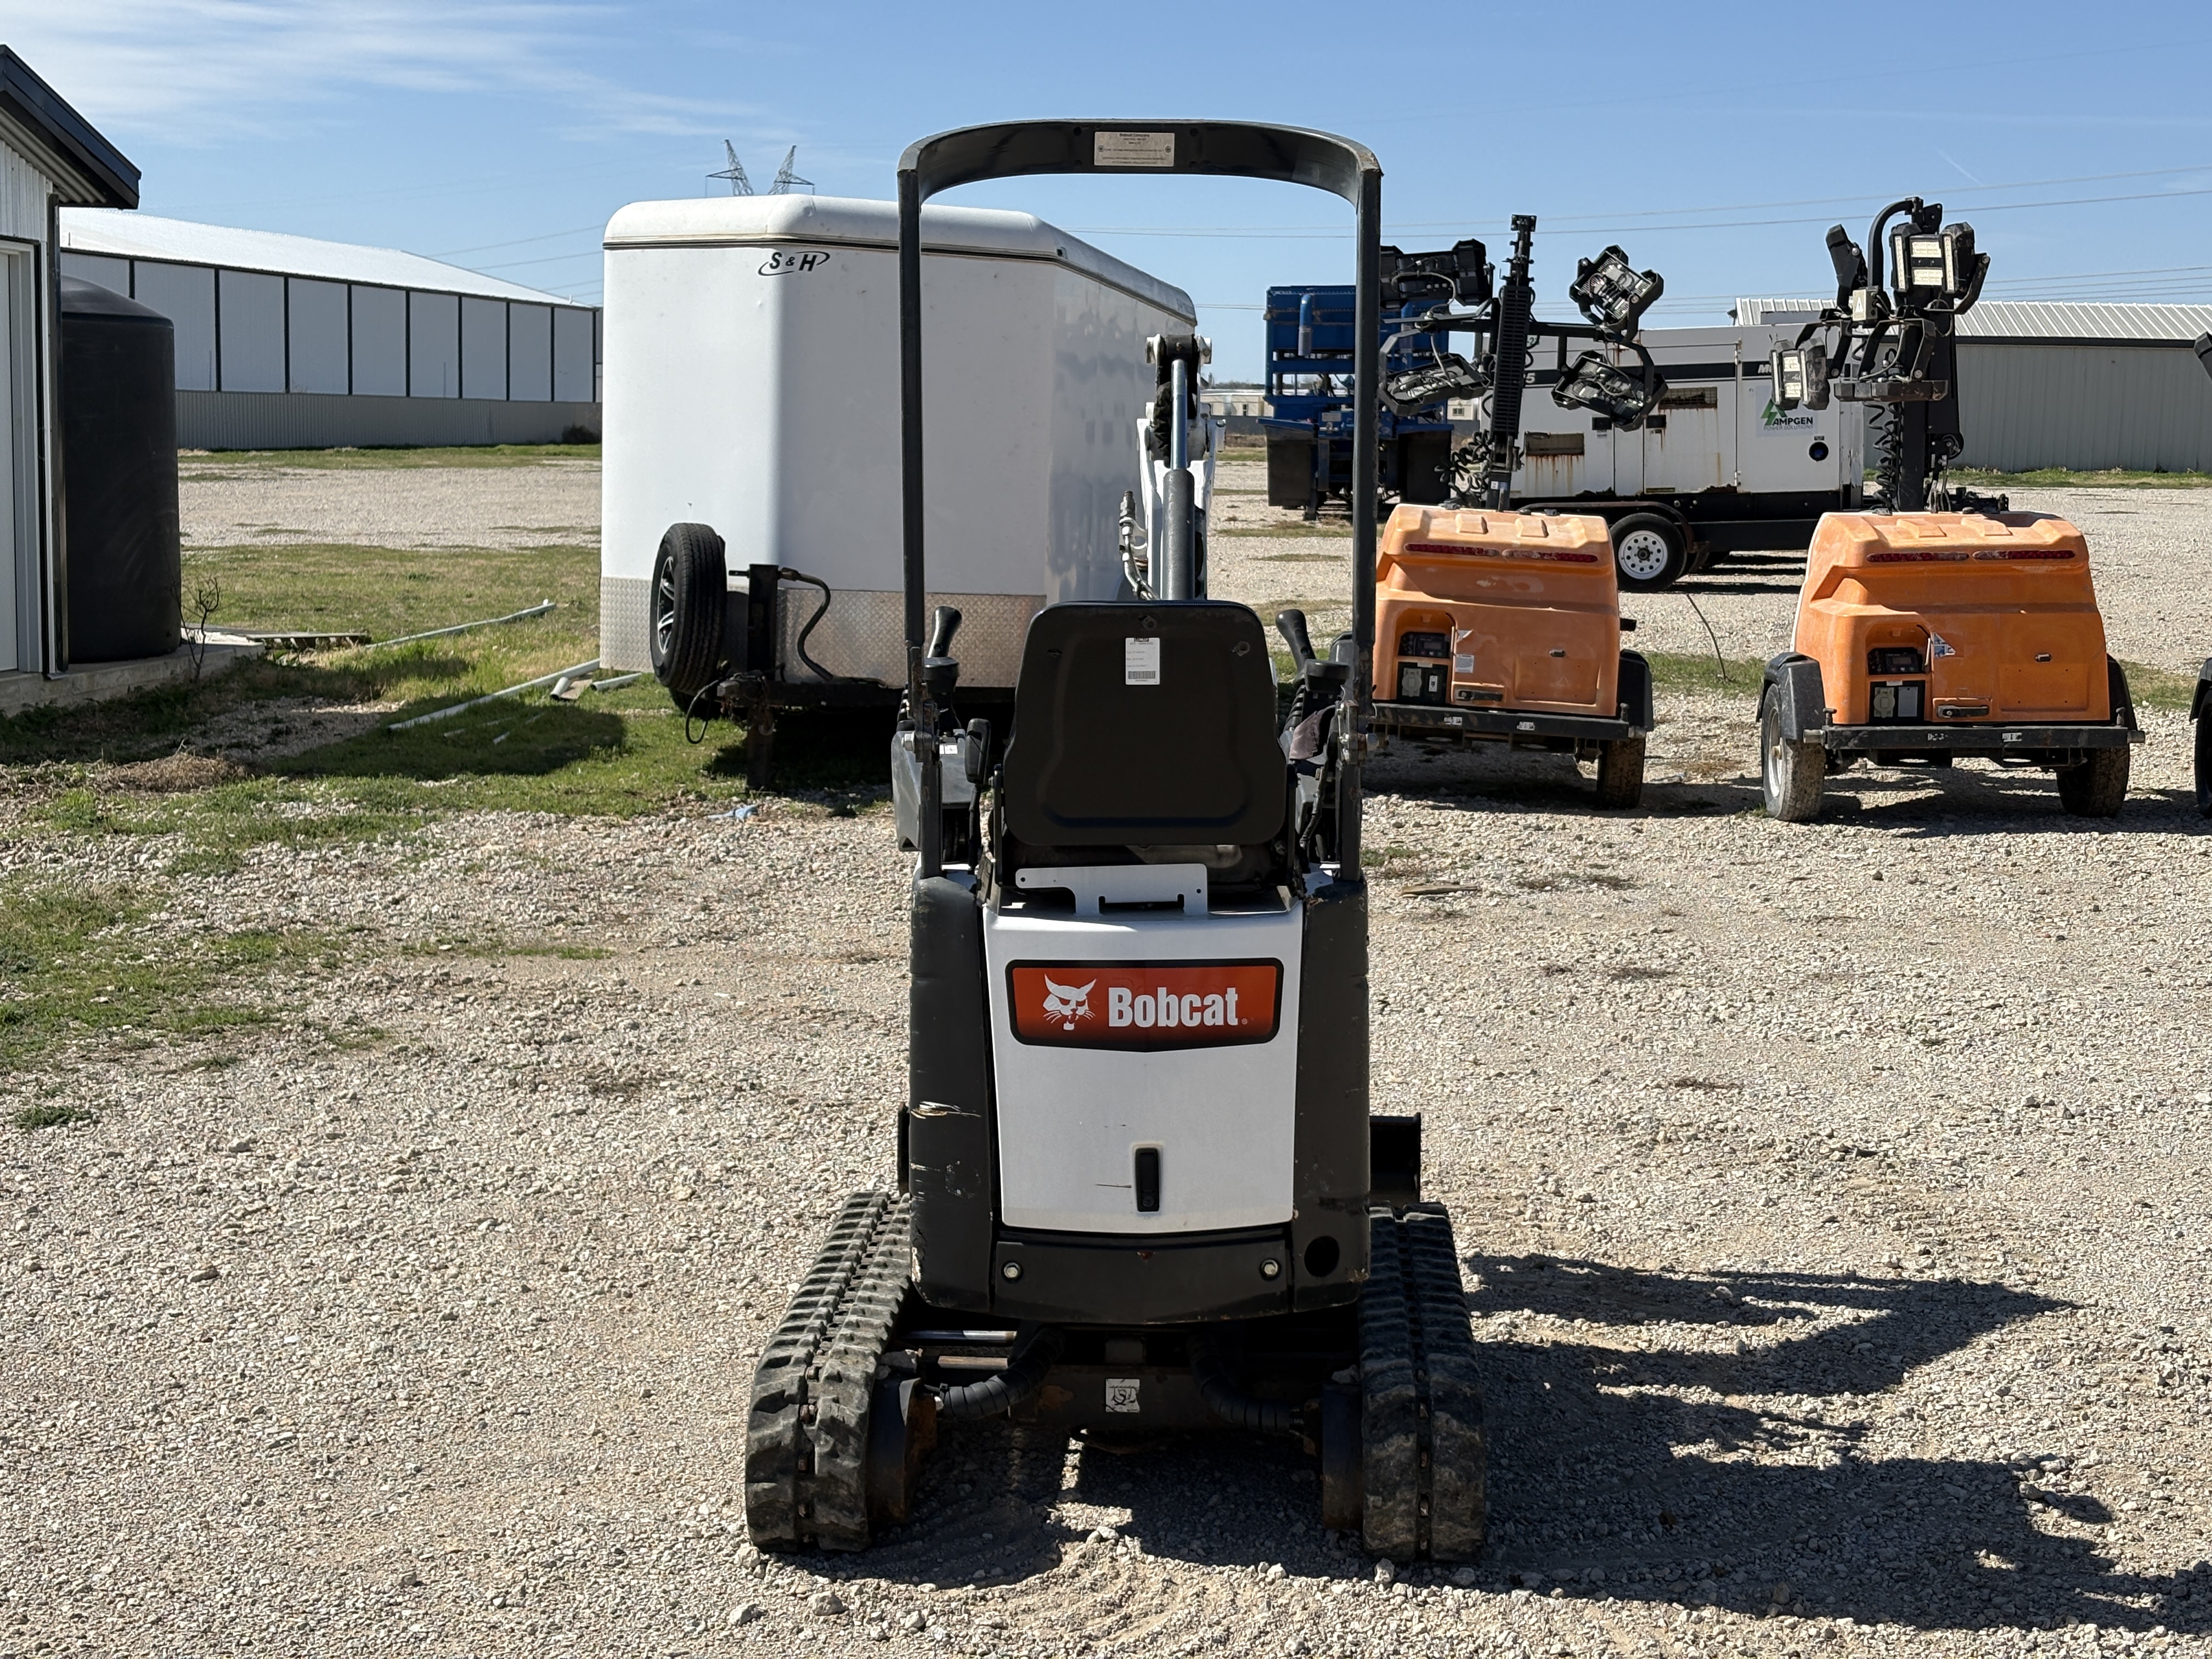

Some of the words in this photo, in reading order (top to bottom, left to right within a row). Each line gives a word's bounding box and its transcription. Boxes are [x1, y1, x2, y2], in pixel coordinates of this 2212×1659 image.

[769, 252, 782, 269] S
[786, 256, 795, 266] &
[798, 254, 817, 272] H
[1772, 416, 1813, 426] AMPGEN
[1108, 987, 1238, 1028] Bobcat
